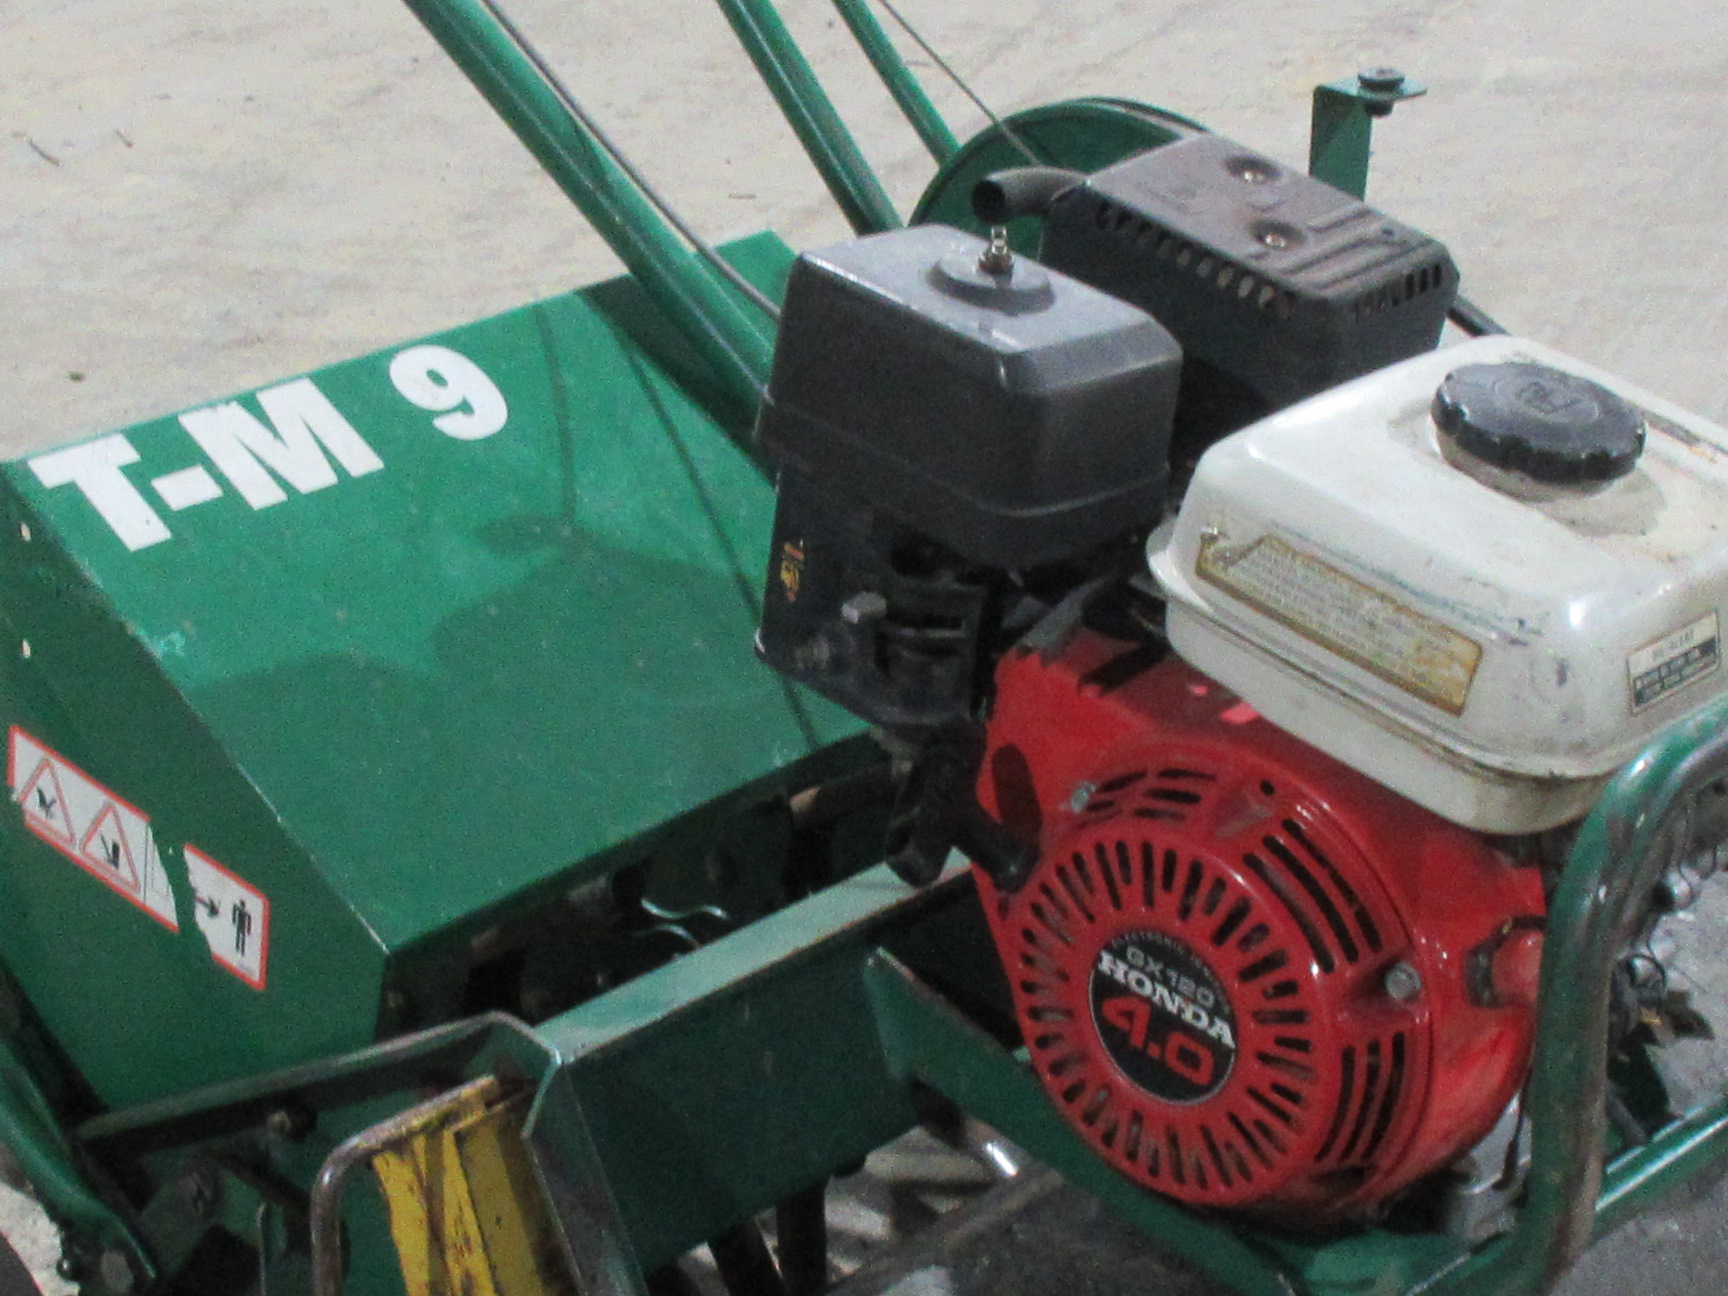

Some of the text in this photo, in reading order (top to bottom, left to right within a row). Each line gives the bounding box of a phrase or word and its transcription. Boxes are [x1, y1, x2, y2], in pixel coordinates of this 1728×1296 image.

[28, 344, 508, 552] T-M 9
[1098, 949, 1236, 1049] HONDA
[1102, 996, 1214, 1086] 4.0
